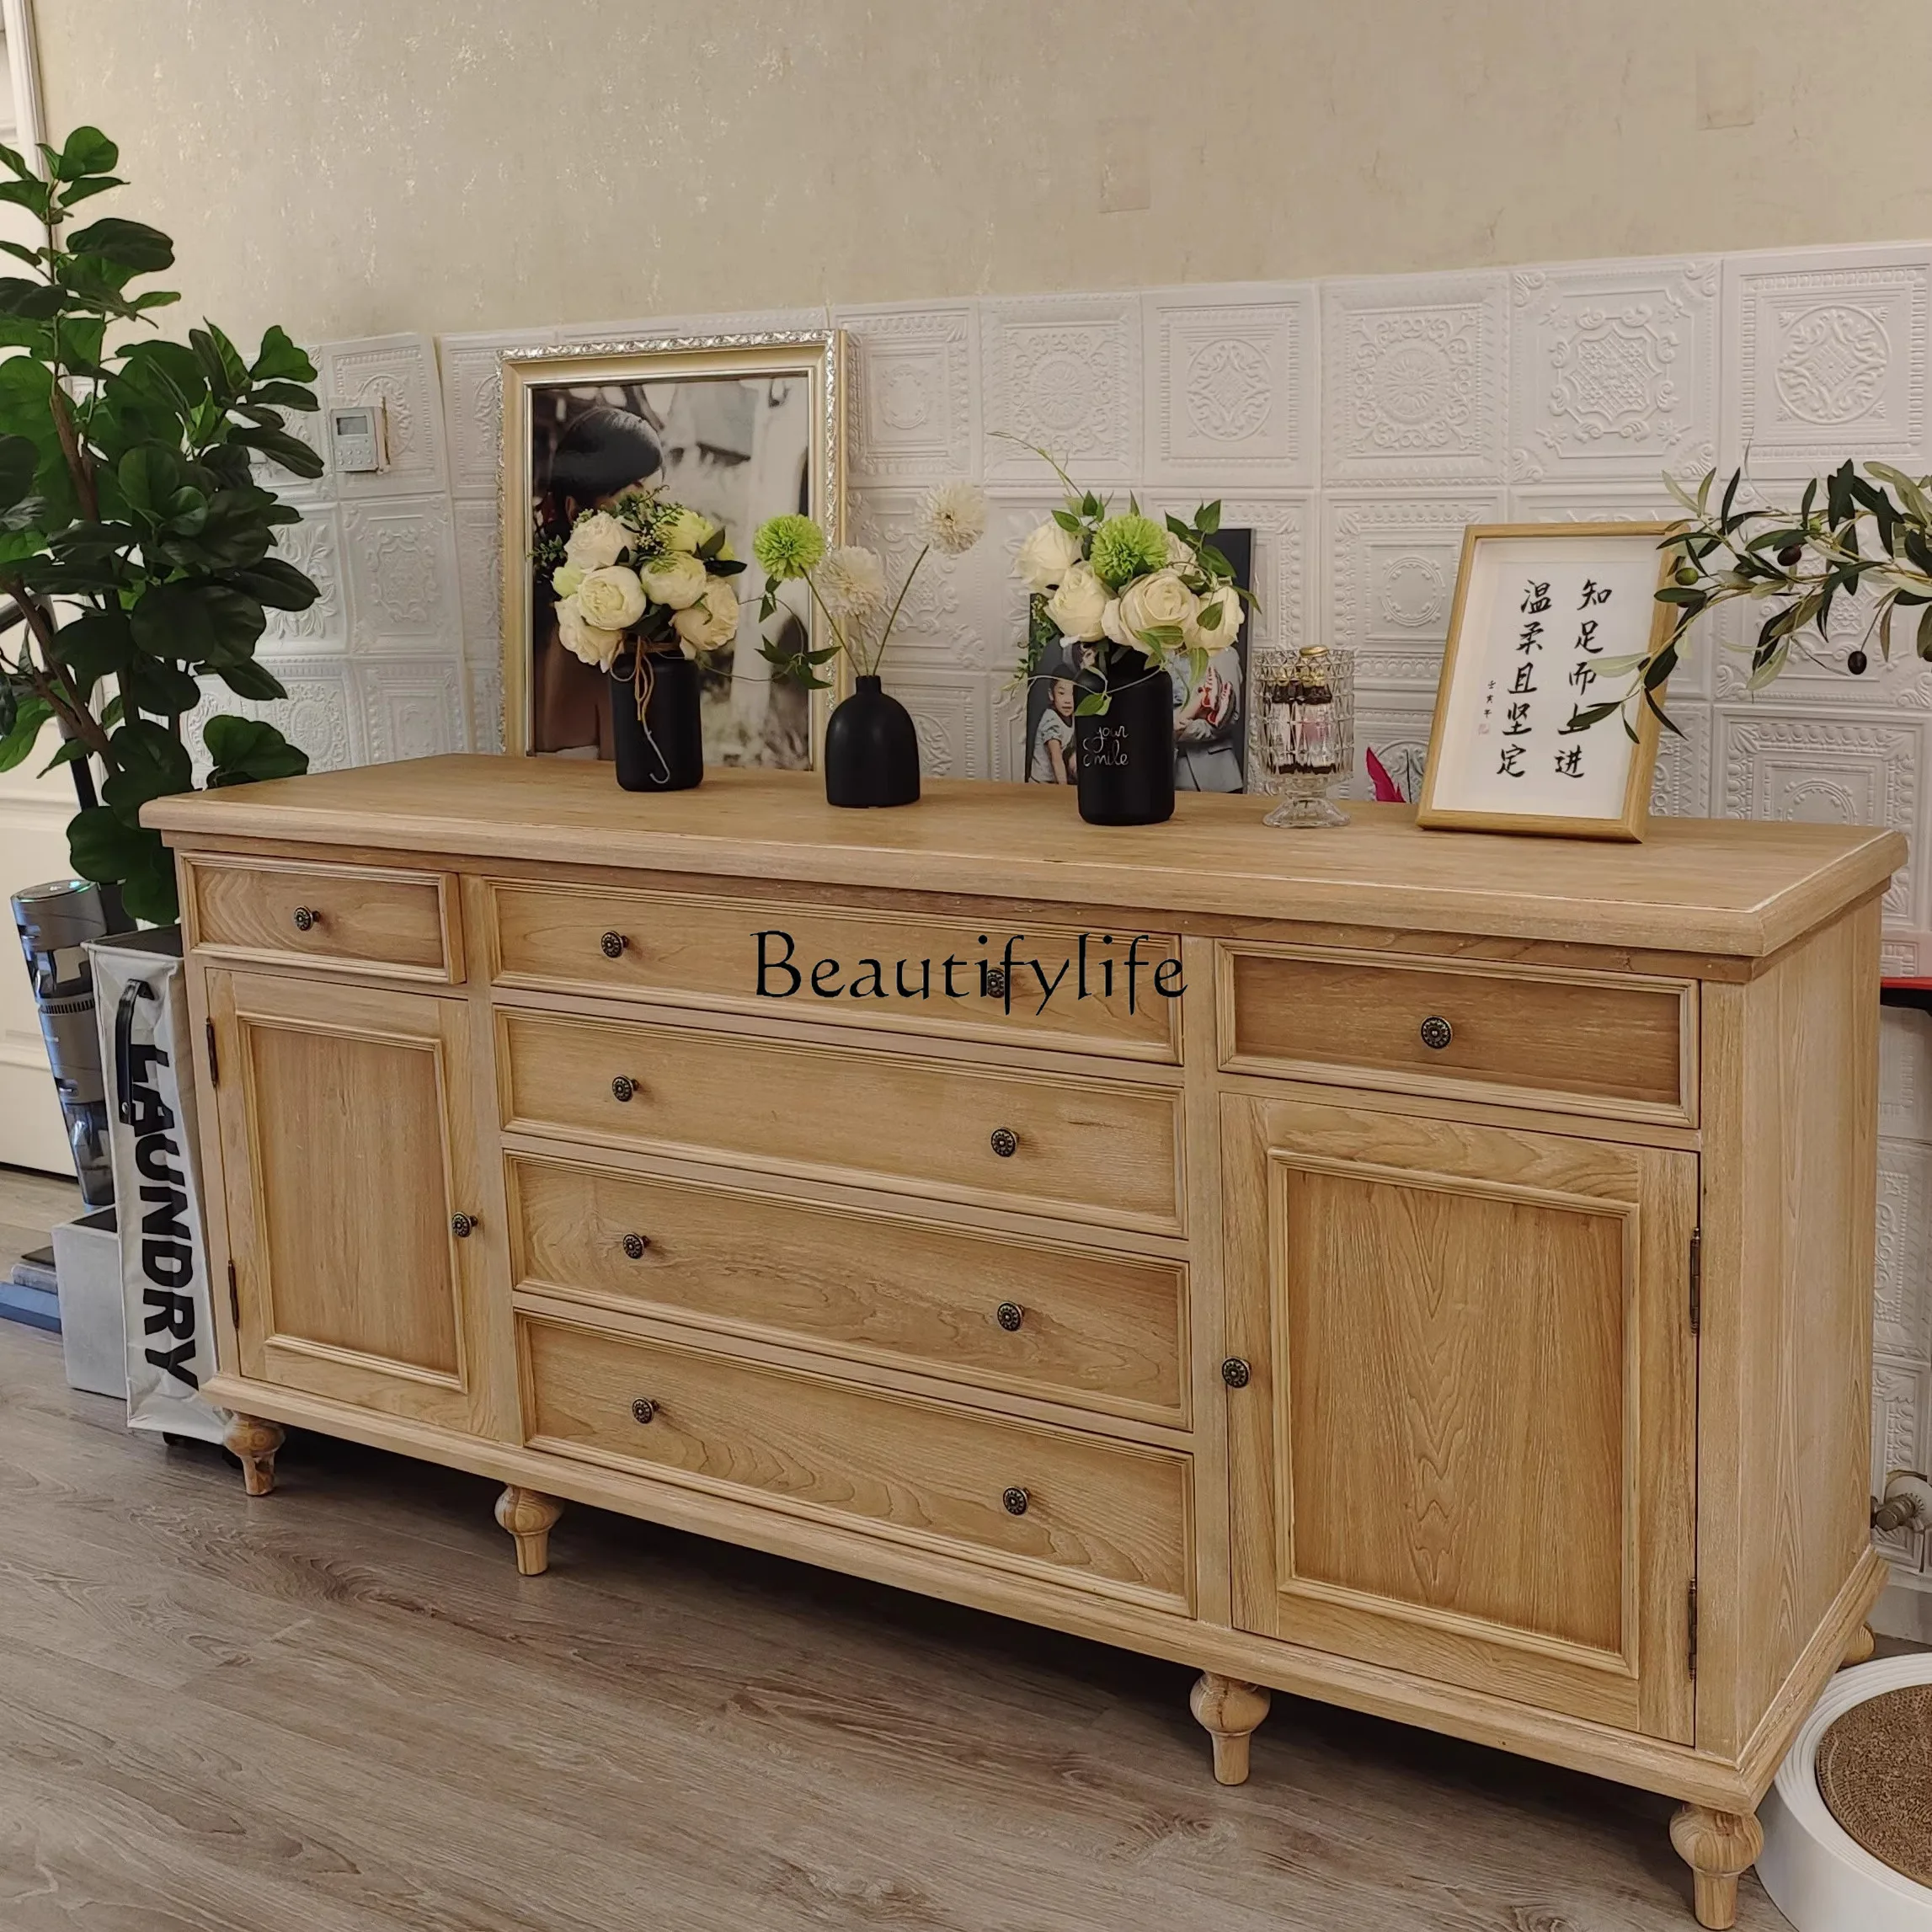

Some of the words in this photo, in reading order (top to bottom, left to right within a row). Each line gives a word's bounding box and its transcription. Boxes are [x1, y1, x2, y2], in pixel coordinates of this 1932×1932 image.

[1497, 579, 1552, 777] 温柔且坚定
[1554, 579, 1612, 778] 知足而上进
[131, 1044, 199, 1391] LAUNDRY
